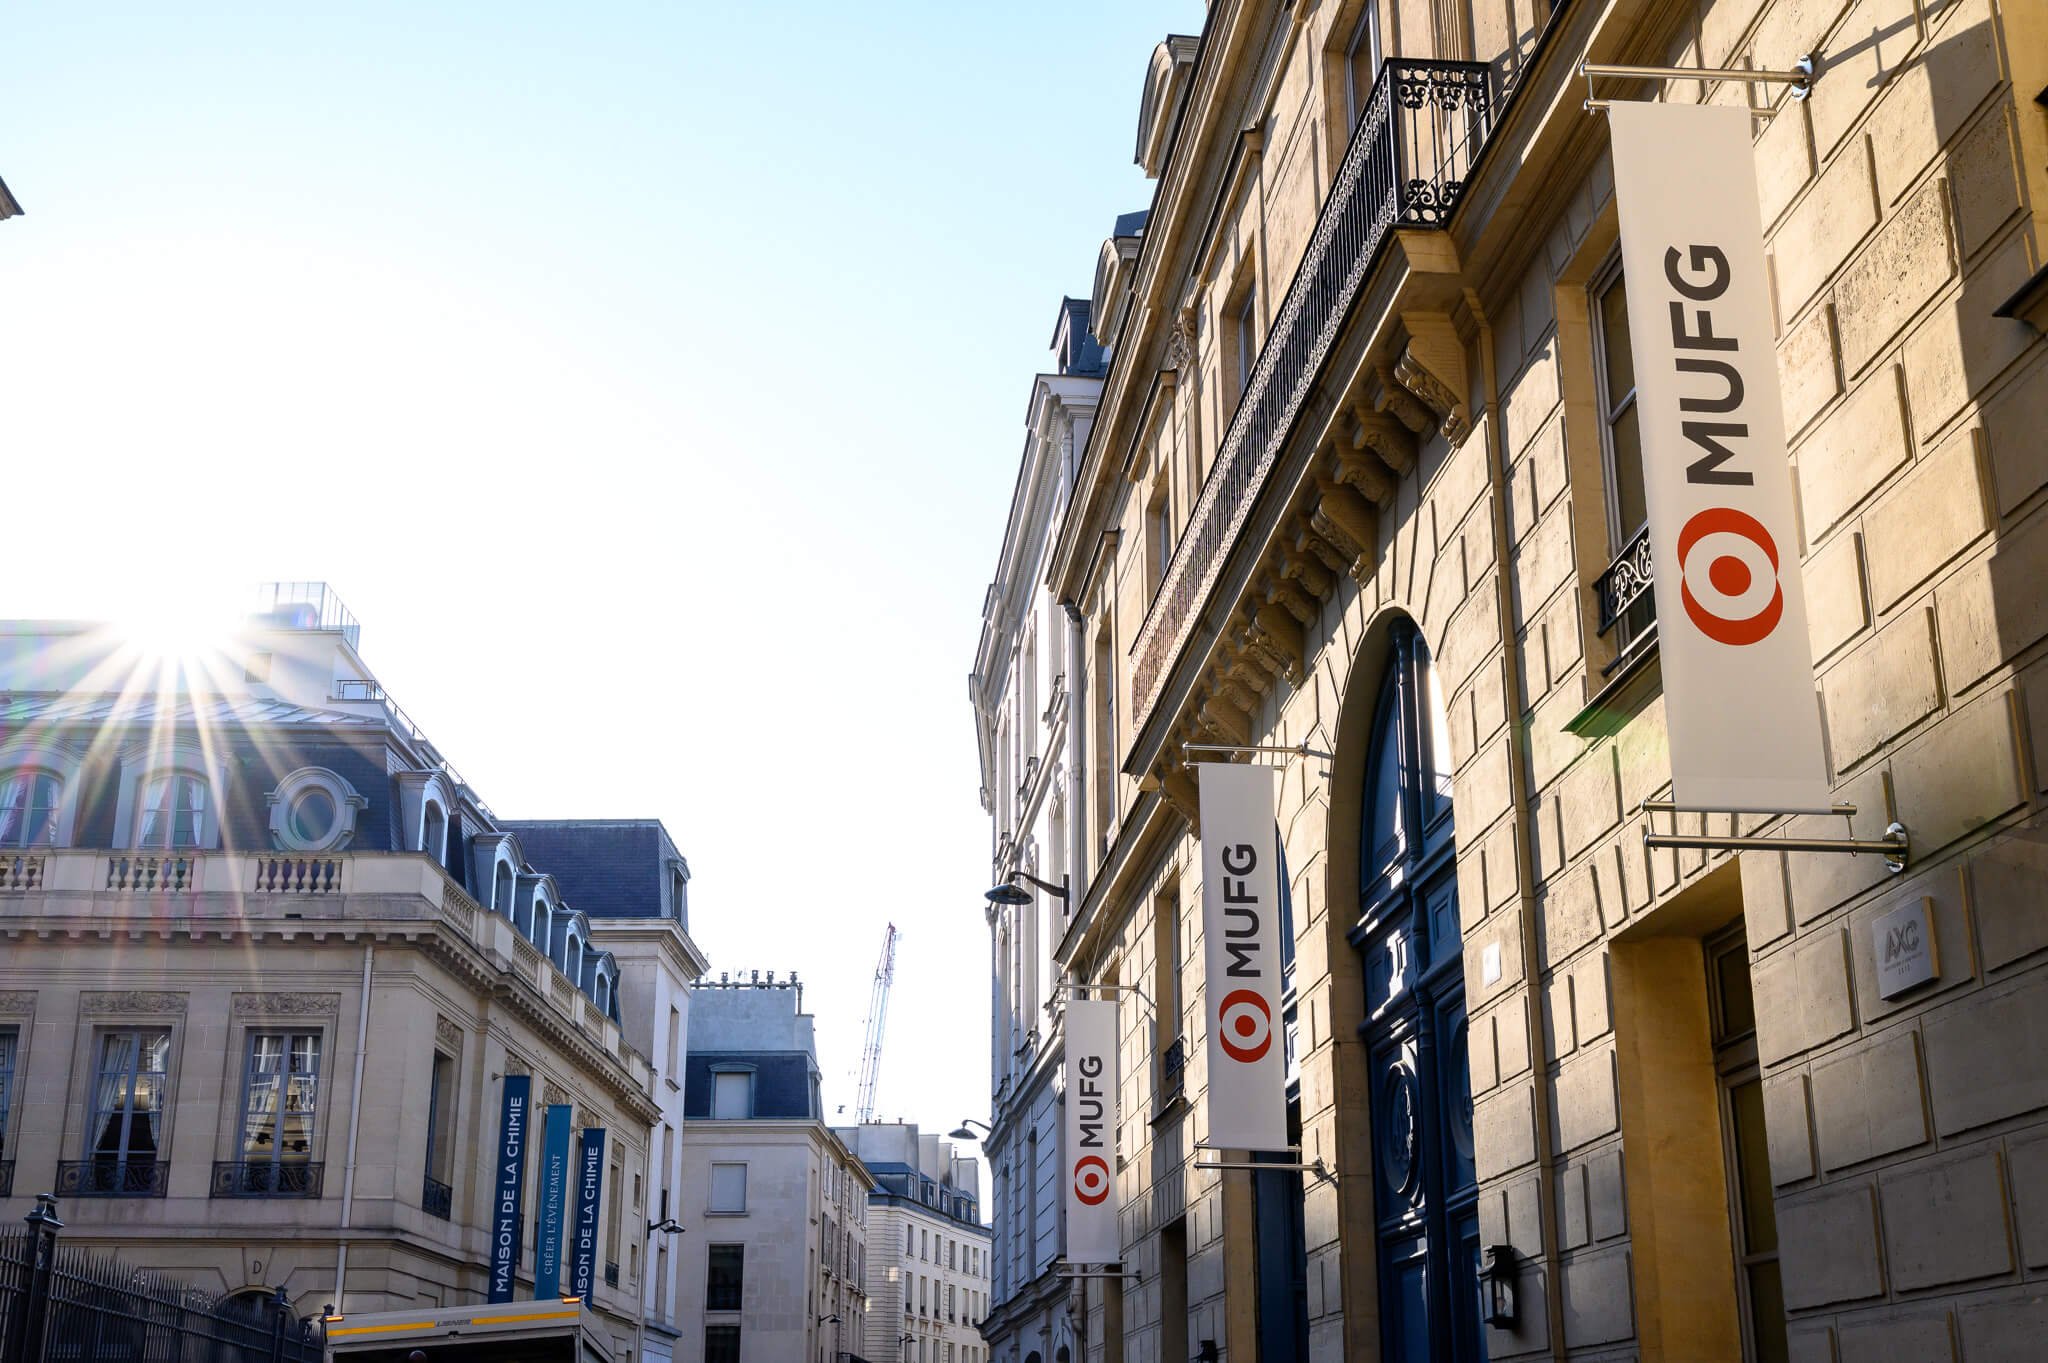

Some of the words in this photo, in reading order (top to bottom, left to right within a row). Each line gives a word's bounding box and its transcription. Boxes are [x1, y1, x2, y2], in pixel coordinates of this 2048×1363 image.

[1664, 245, 1754, 486] MUFG
[1222, 844, 1261, 977] MUFG
[506, 1097, 522, 1158] CHIMIE
[1079, 1056, 1104, 1147] MUFG
[504, 1162, 518, 1185] LA
[584, 1146, 598, 1200] CHIMIE
[502, 1190, 516, 1213] DE
[583, 1204, 594, 1223] LA
[496, 1219, 513, 1292] MAISON
[544, 1236, 555, 1275] CRÉER
[580, 1228, 592, 1249] DE
[577, 1254, 590, 1305] AISON
